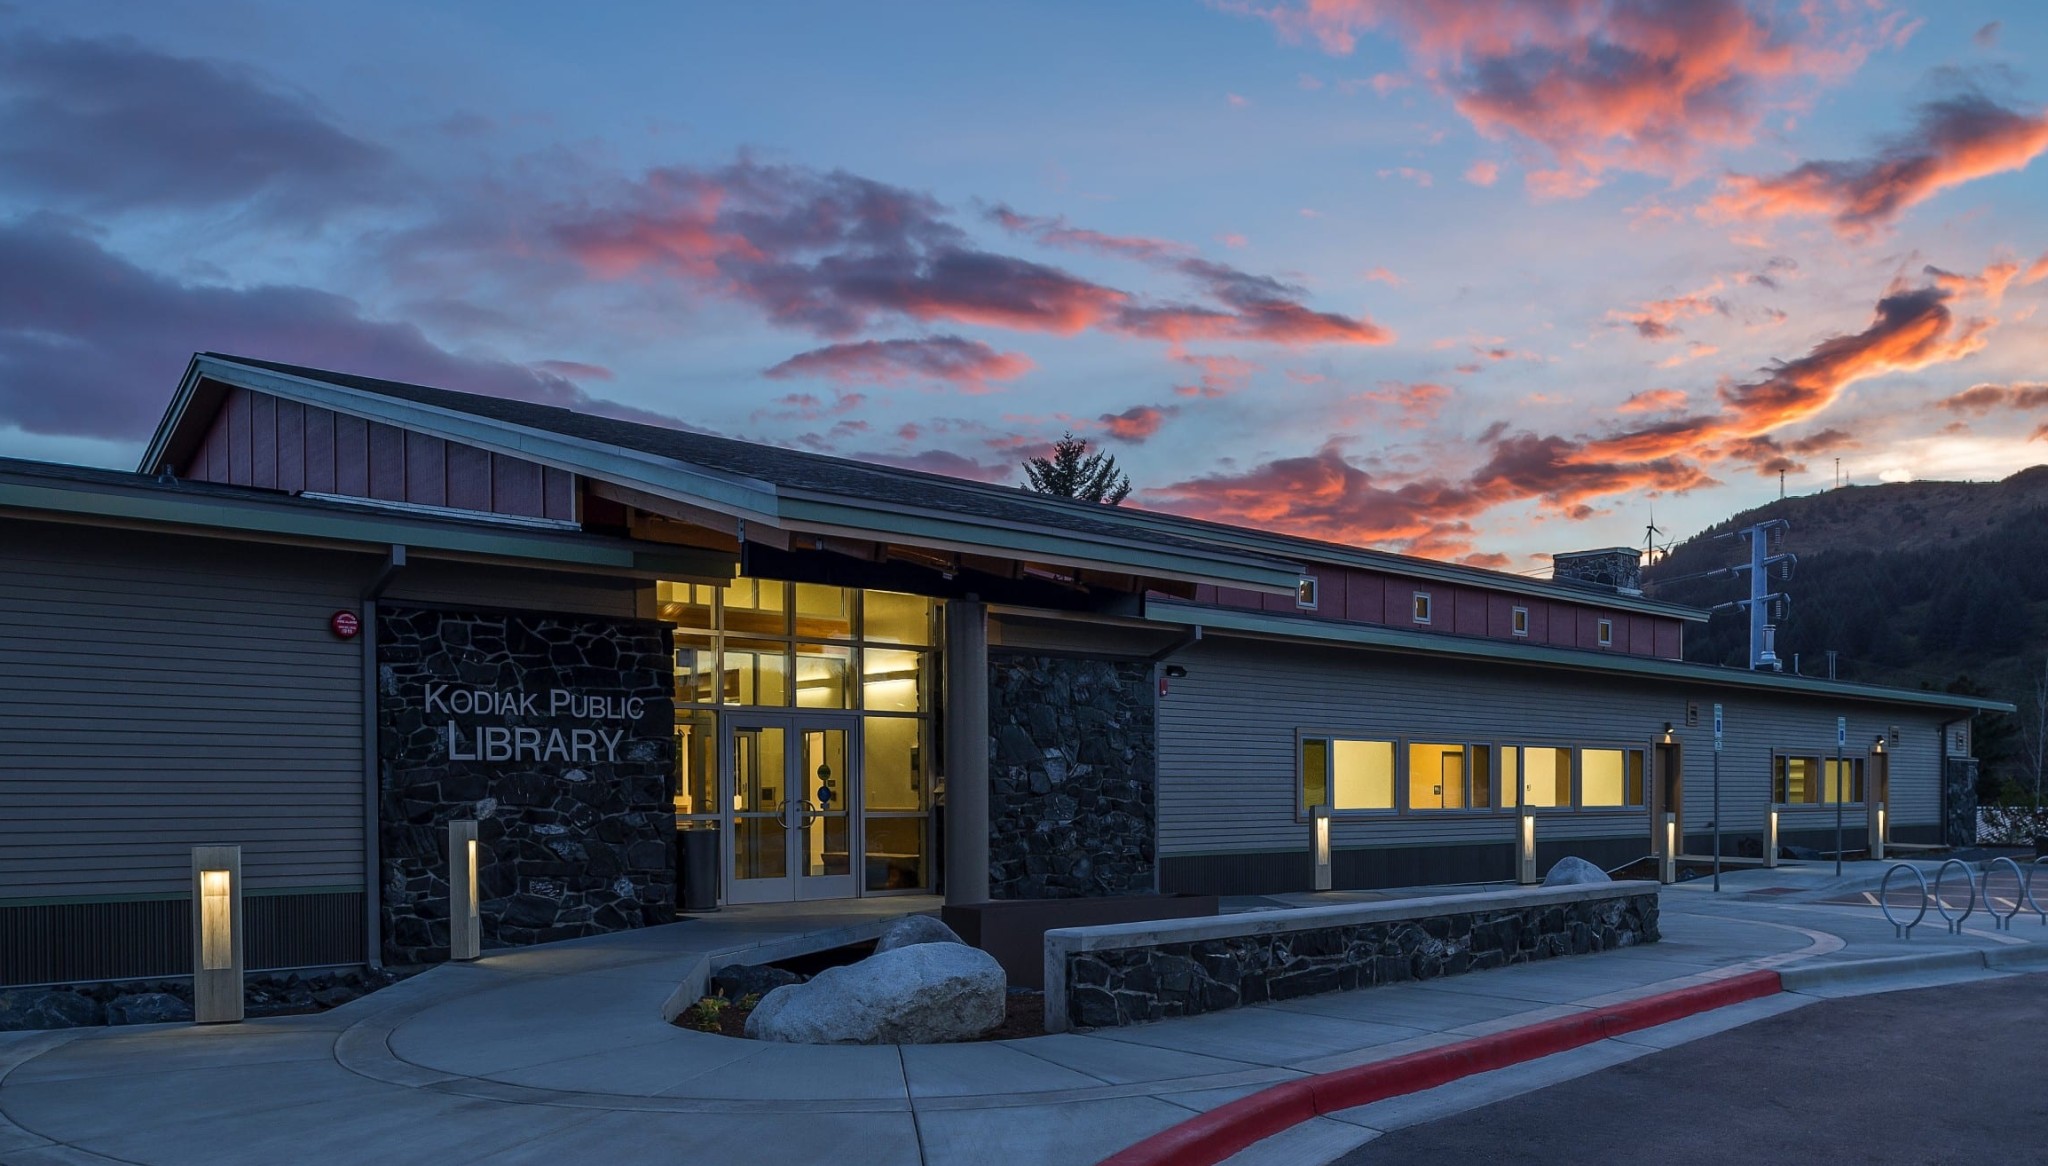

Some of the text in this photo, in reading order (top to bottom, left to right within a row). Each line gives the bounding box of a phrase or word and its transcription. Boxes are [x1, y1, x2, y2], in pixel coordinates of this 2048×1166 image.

[425, 684, 644, 719] KODIAK PUBLIC
[448, 720, 624, 762] LIBRARY
